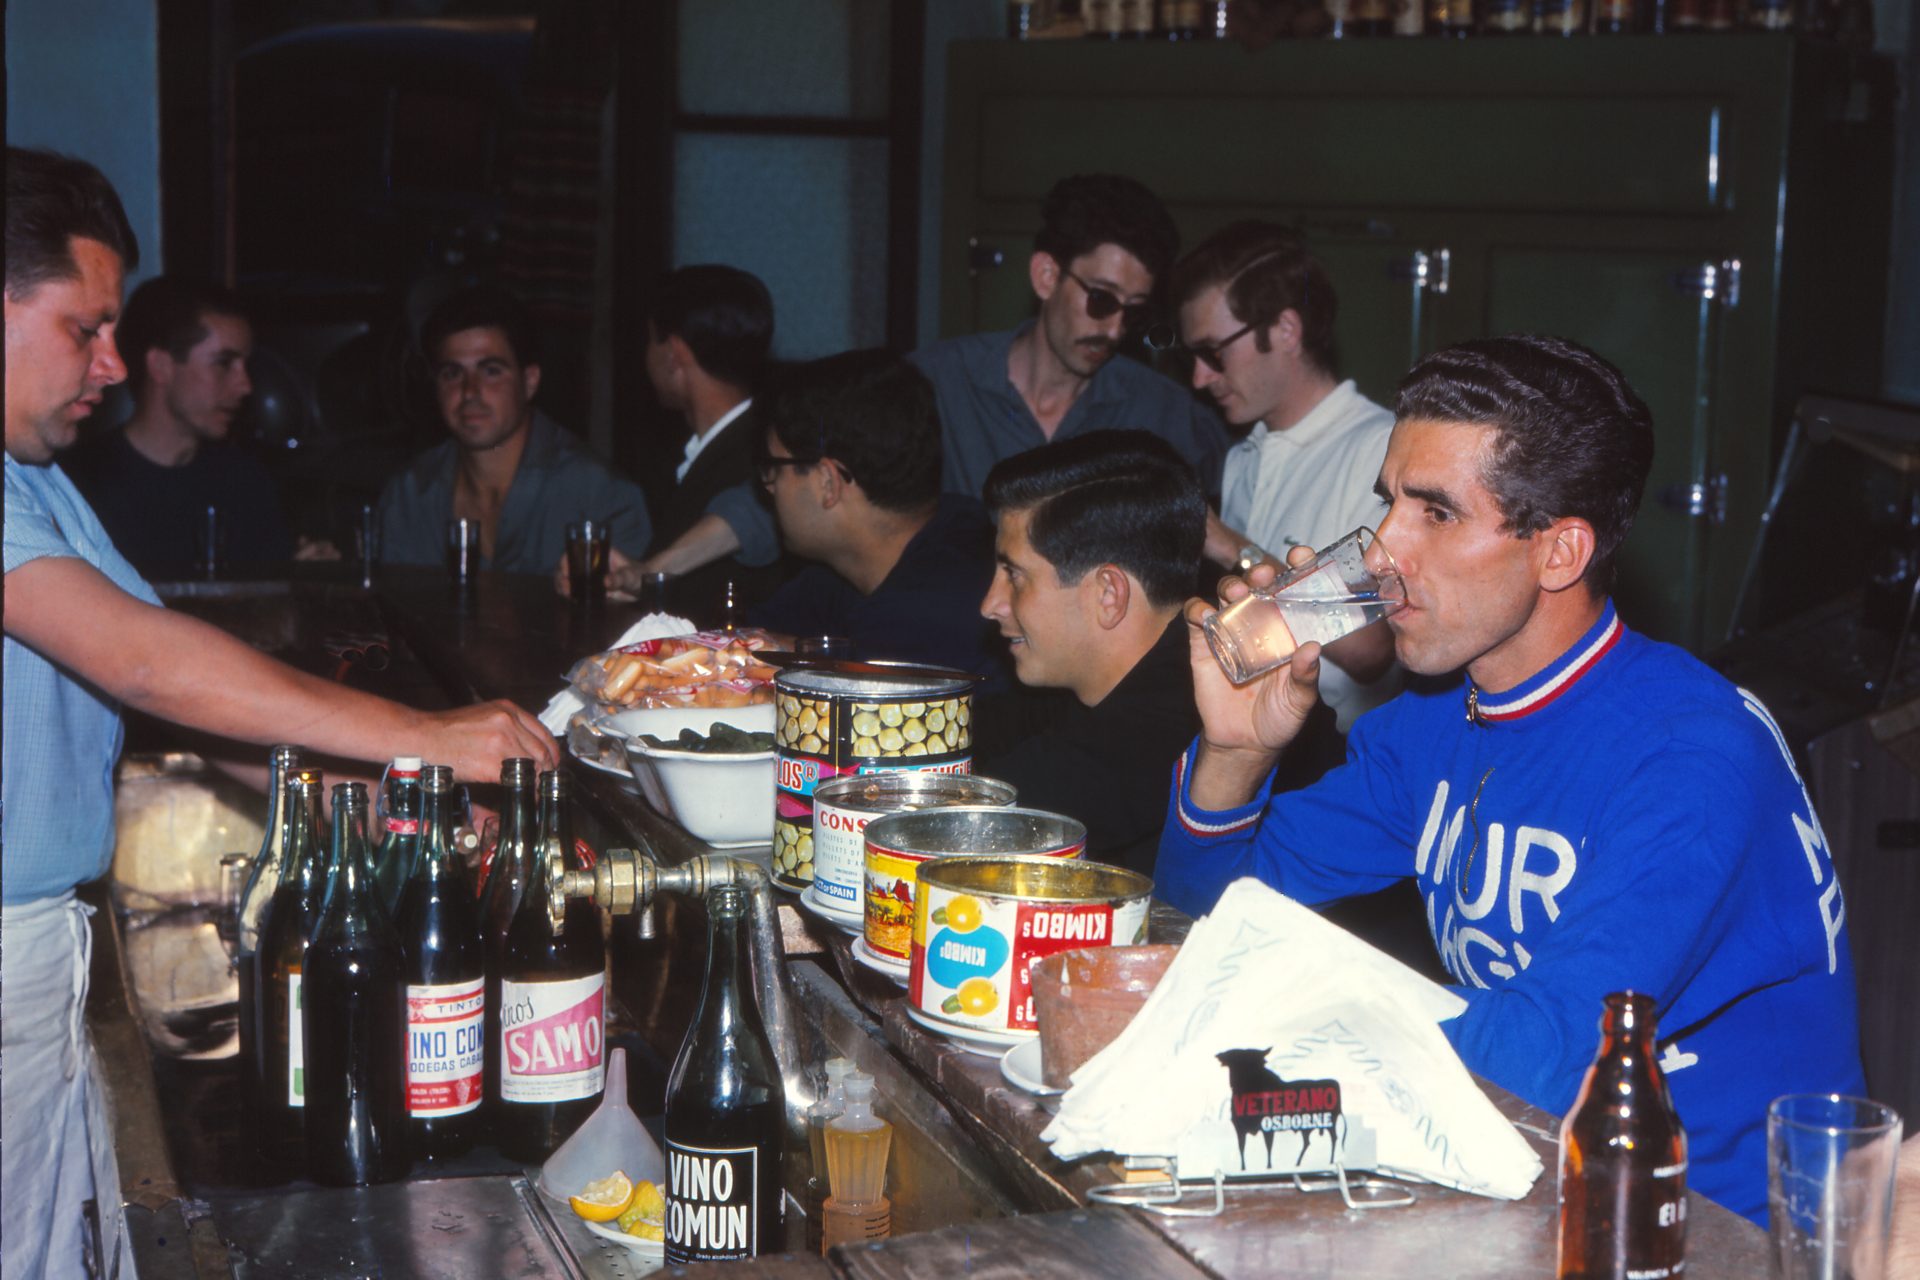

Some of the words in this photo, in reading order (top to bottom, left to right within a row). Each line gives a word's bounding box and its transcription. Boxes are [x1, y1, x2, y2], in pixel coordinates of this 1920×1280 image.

[828, 884, 855, 900] SPAIN
[437, 997, 483, 1014] TINTO
[409, 1031, 447, 1060] INO
[508, 1015, 601, 1073] SAMO
[1233, 1087, 1338, 1117] VETERANO
[1260, 1112, 1334, 1132] OSBORNE
[670, 1151, 734, 1202] VINO
[666, 1197, 747, 1250] COMUN
